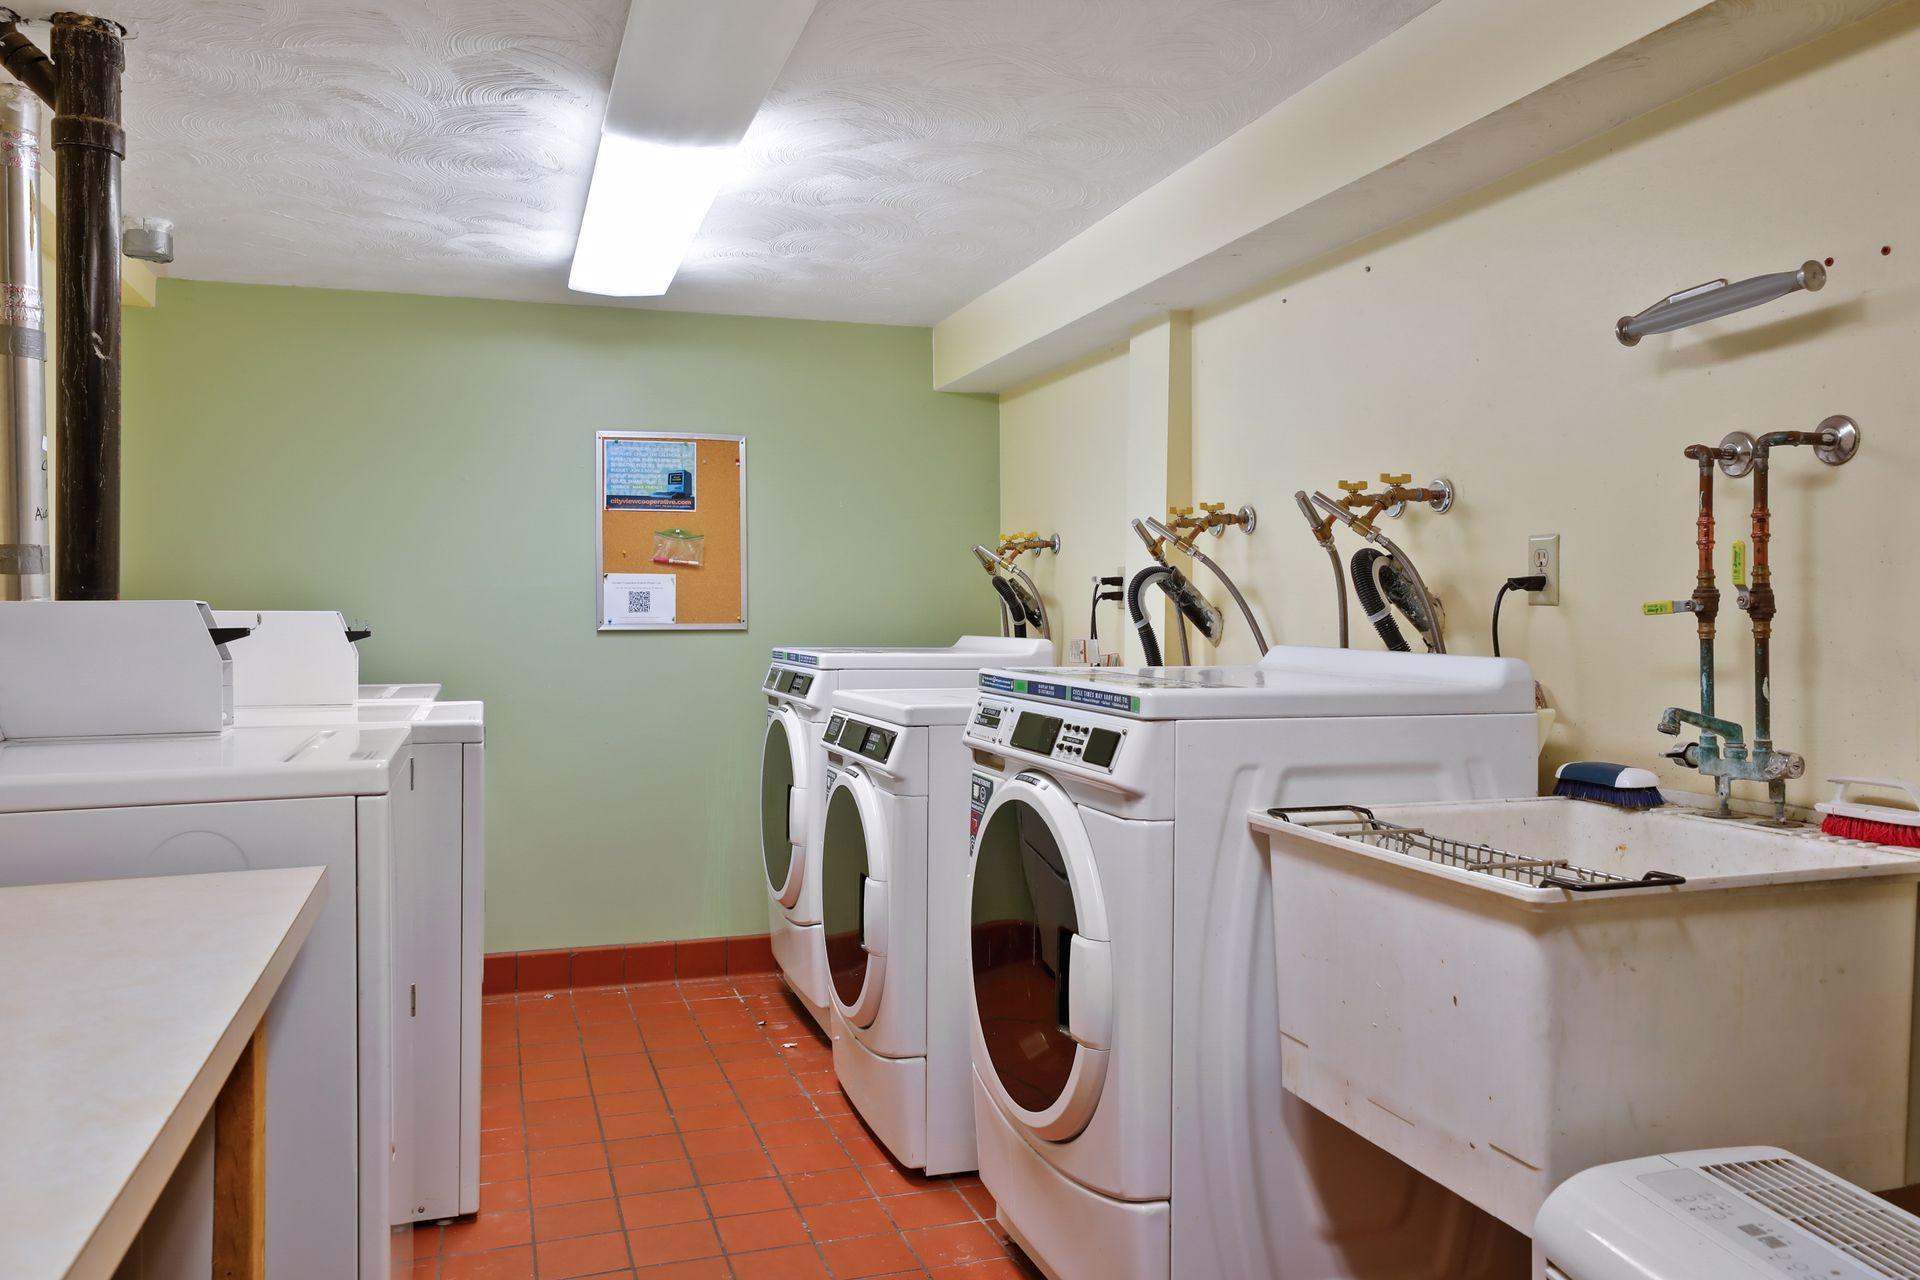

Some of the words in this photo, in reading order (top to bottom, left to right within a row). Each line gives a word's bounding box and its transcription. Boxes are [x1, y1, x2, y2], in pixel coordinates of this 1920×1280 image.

[610, 498, 692, 506] cityviewcooperative.com
[1072, 689, 1083, 697] CYCLE
[1095, 692, 1103, 700] MAY
[1113, 695, 1122, 703] DUE
